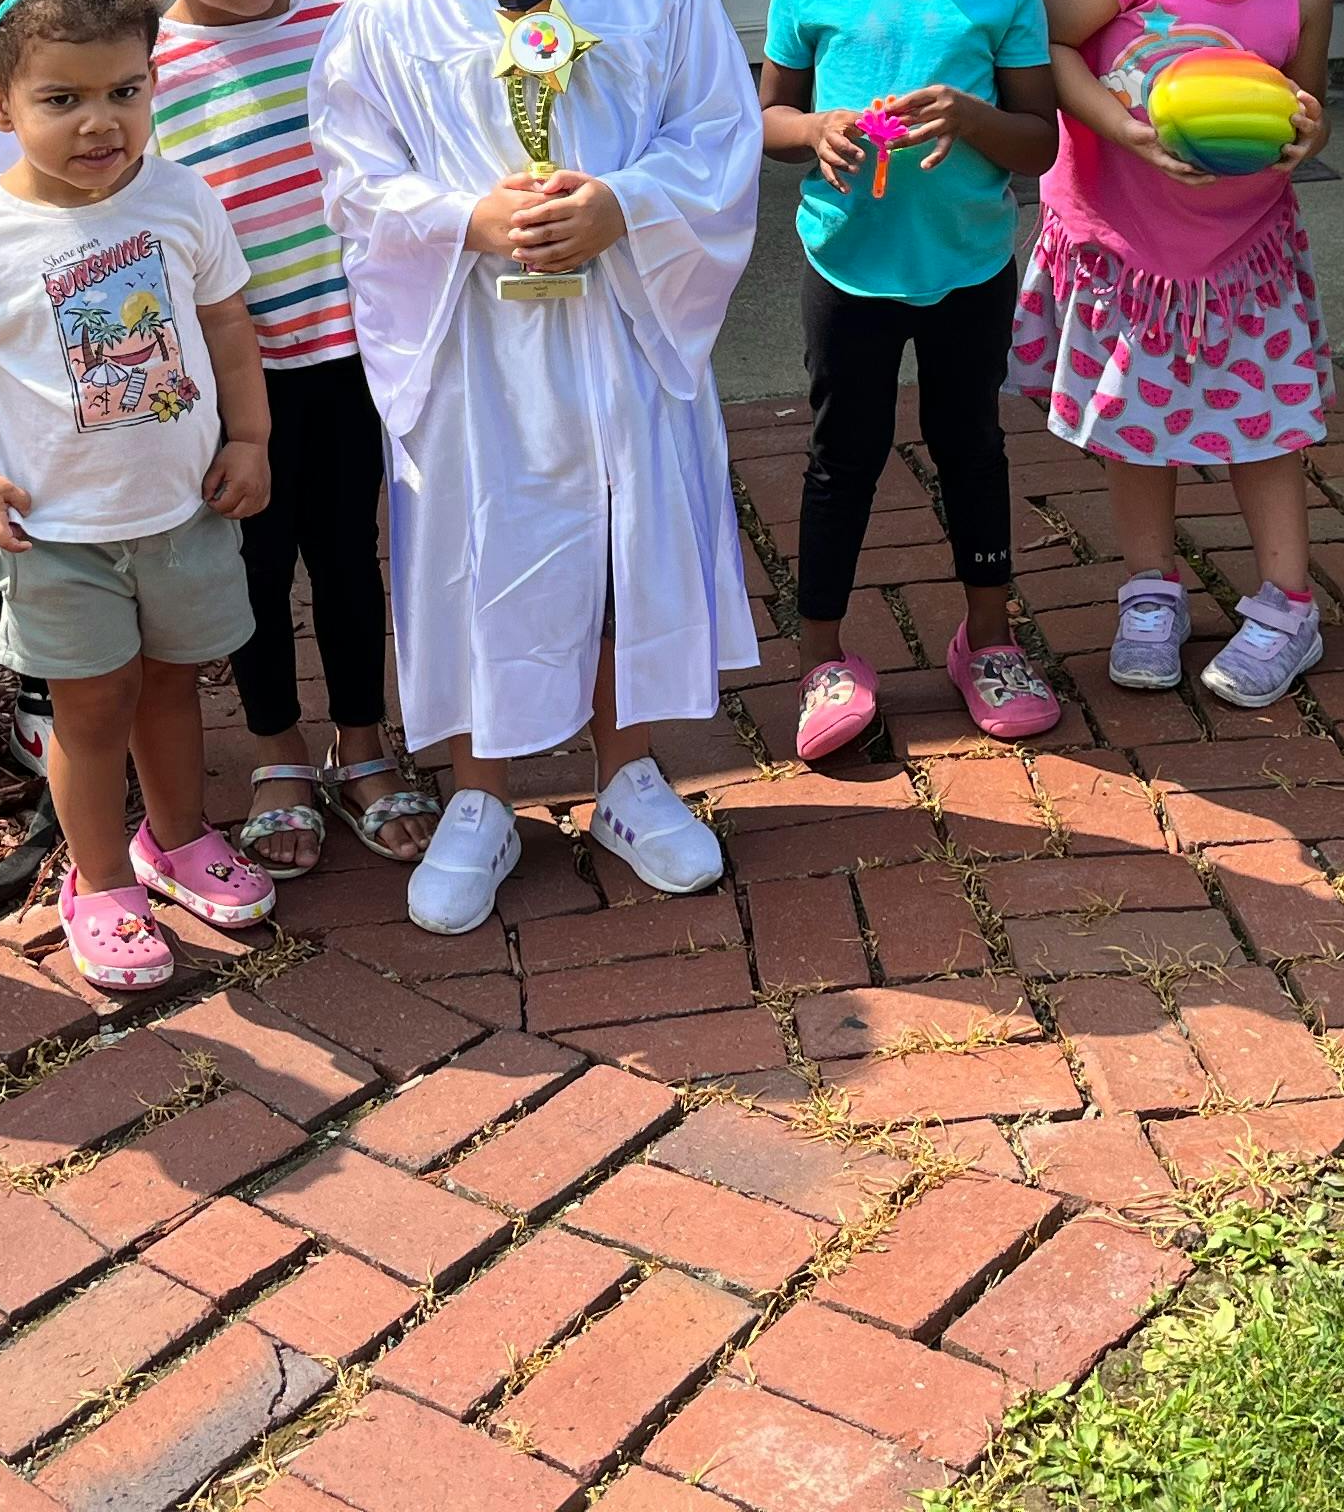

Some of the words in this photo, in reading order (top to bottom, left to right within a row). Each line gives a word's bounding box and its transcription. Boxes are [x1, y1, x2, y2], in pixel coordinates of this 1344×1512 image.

[44, 250, 75, 267] Share
[77, 237, 101, 257] your
[45, 230, 153, 307] SUNSHINE
